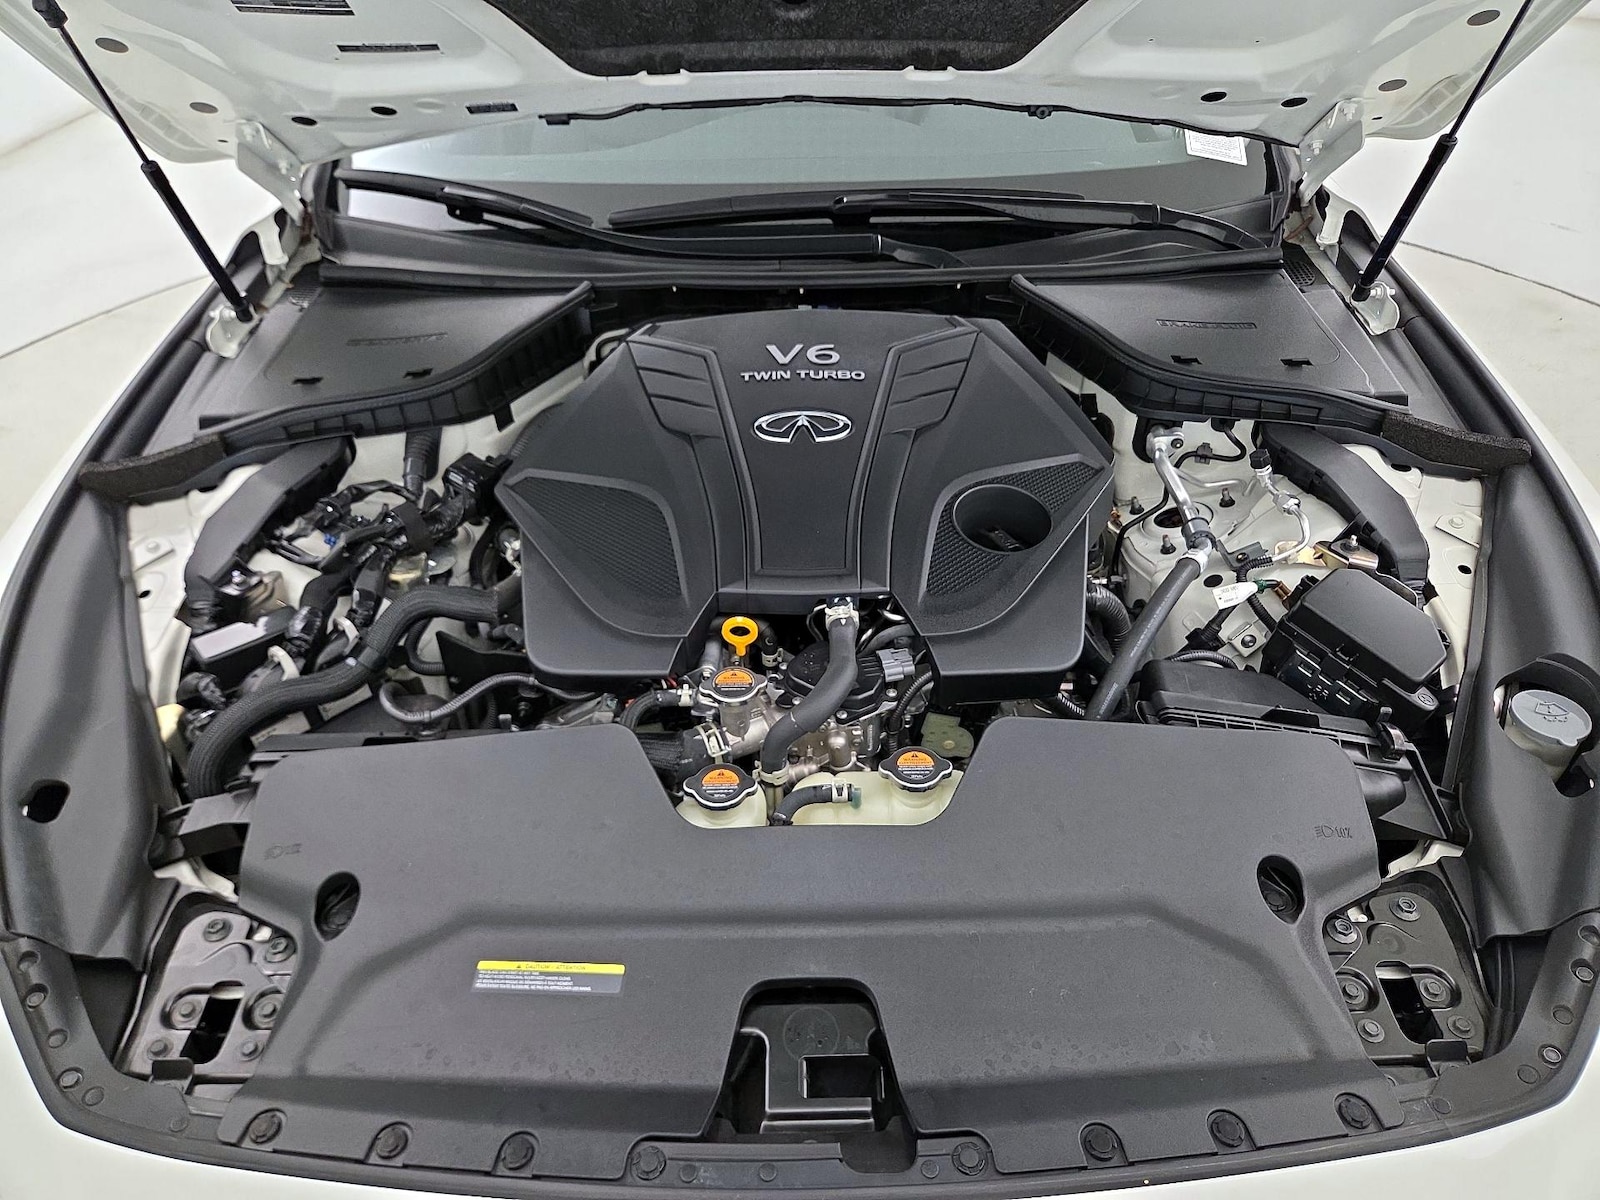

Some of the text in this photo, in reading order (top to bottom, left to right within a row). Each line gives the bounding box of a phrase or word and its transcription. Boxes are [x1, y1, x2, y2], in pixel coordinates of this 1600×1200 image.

[765, 343, 841, 365] V6
[740, 369, 866, 382] TWIN TURBO
